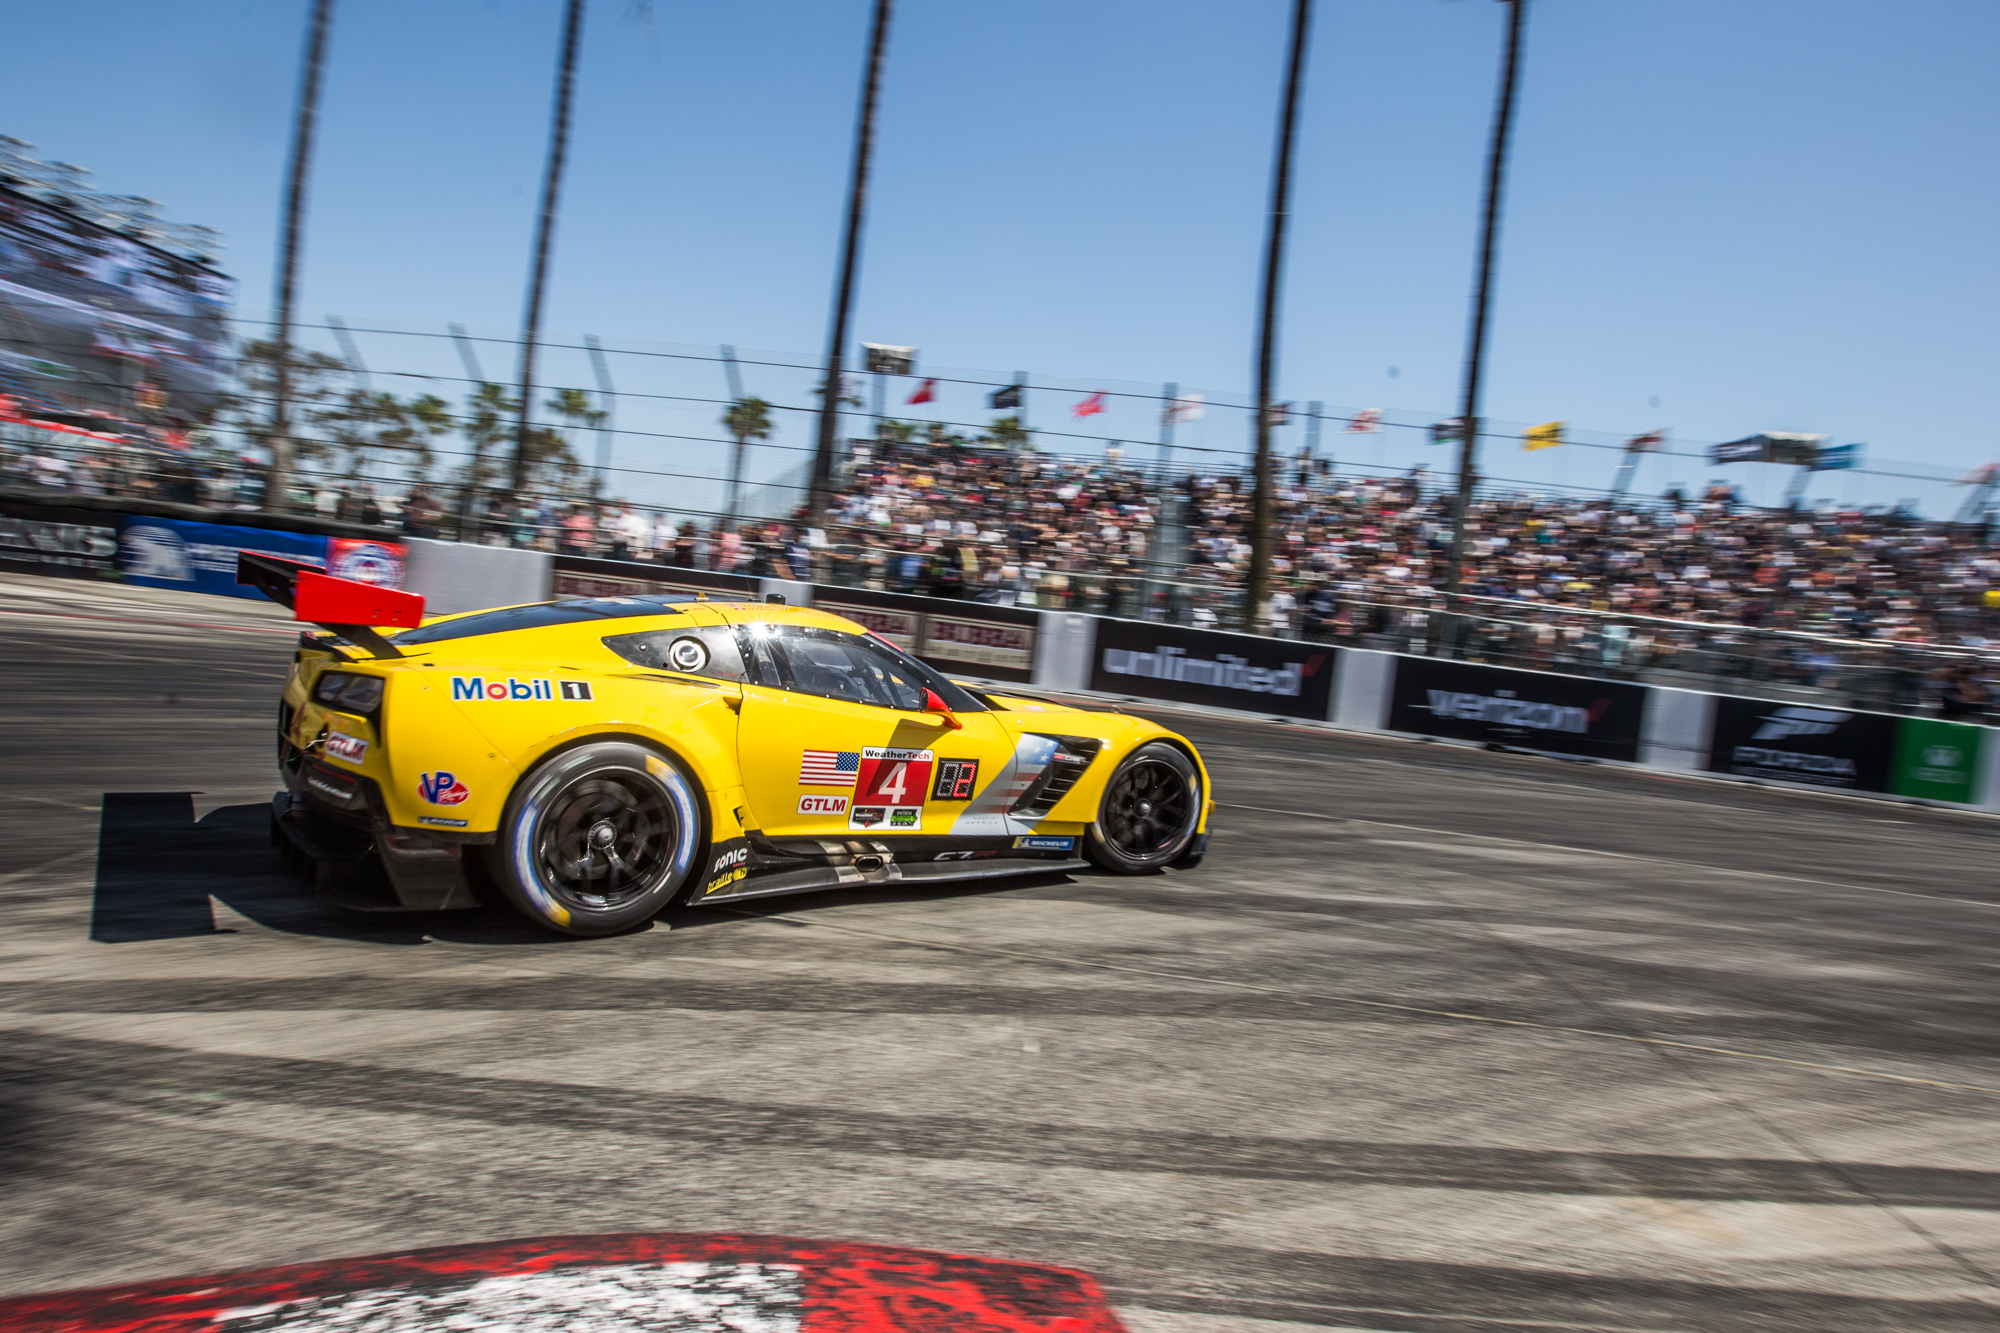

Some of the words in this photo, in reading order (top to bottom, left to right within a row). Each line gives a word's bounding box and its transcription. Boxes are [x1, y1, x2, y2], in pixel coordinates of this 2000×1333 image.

[1103, 646, 1302, 696] unlimited
[452, 677, 552, 700] Mobil
[567, 683, 582, 699] 1
[1426, 690, 1590, 733] verizon
[865, 750, 931, 760] WeatherTech
[419, 771, 456, 804] VP
[878, 762, 907, 804] 4
[801, 798, 847, 812] GTLM
